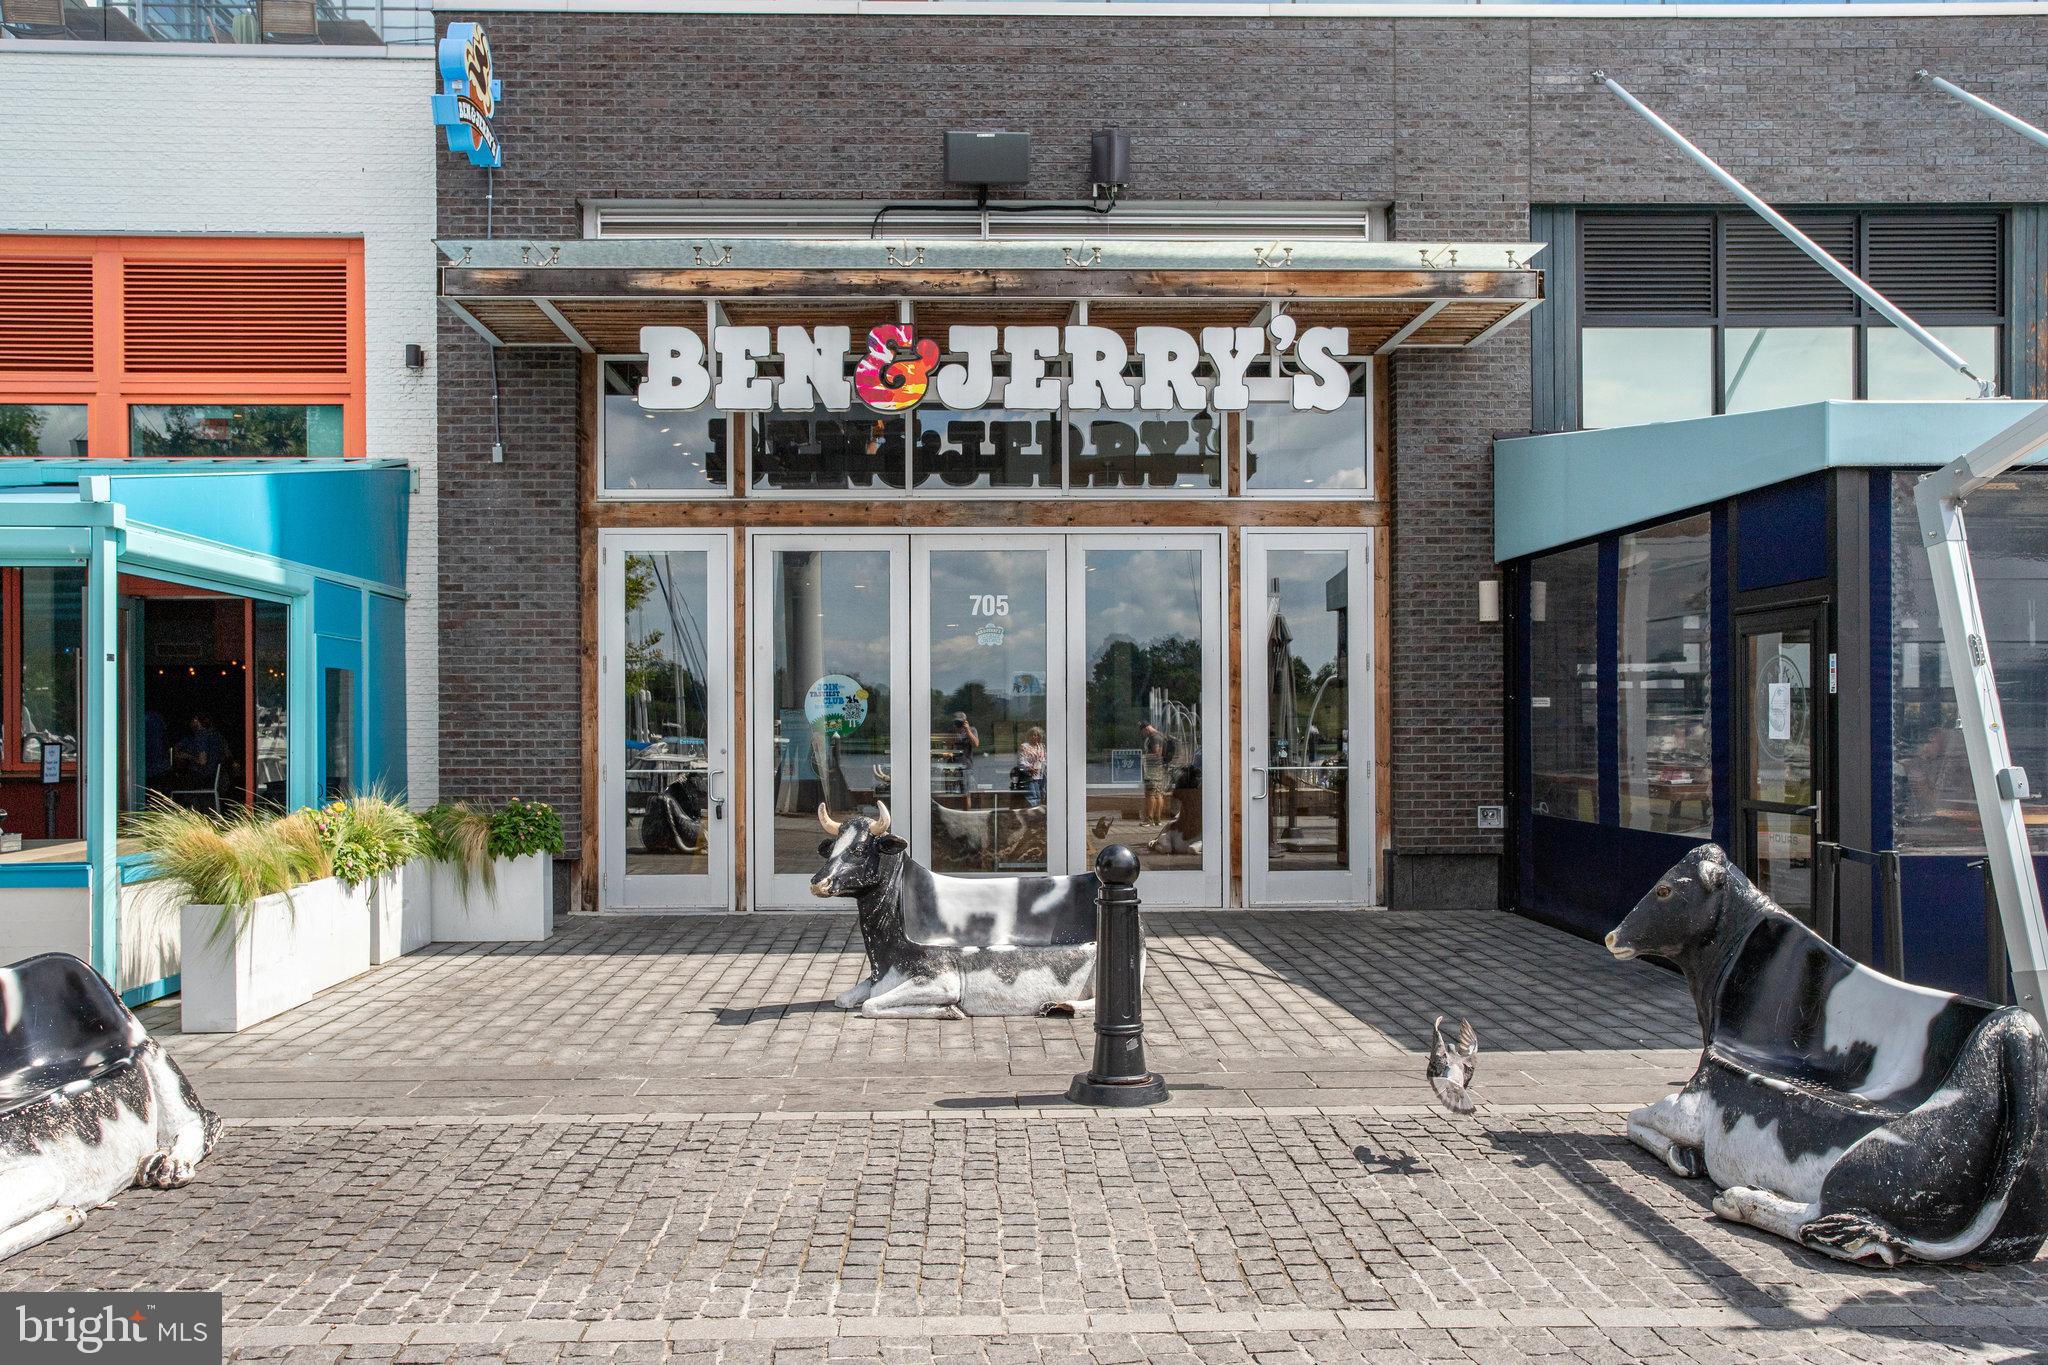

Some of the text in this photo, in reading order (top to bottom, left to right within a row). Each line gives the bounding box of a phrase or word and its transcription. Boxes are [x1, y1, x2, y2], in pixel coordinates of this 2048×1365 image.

[638, 325, 852, 412] BEN
[937, 314, 1351, 412] JERRY'S
[970, 594, 1009, 616] 705
[824, 696, 845, 704] CLUB
